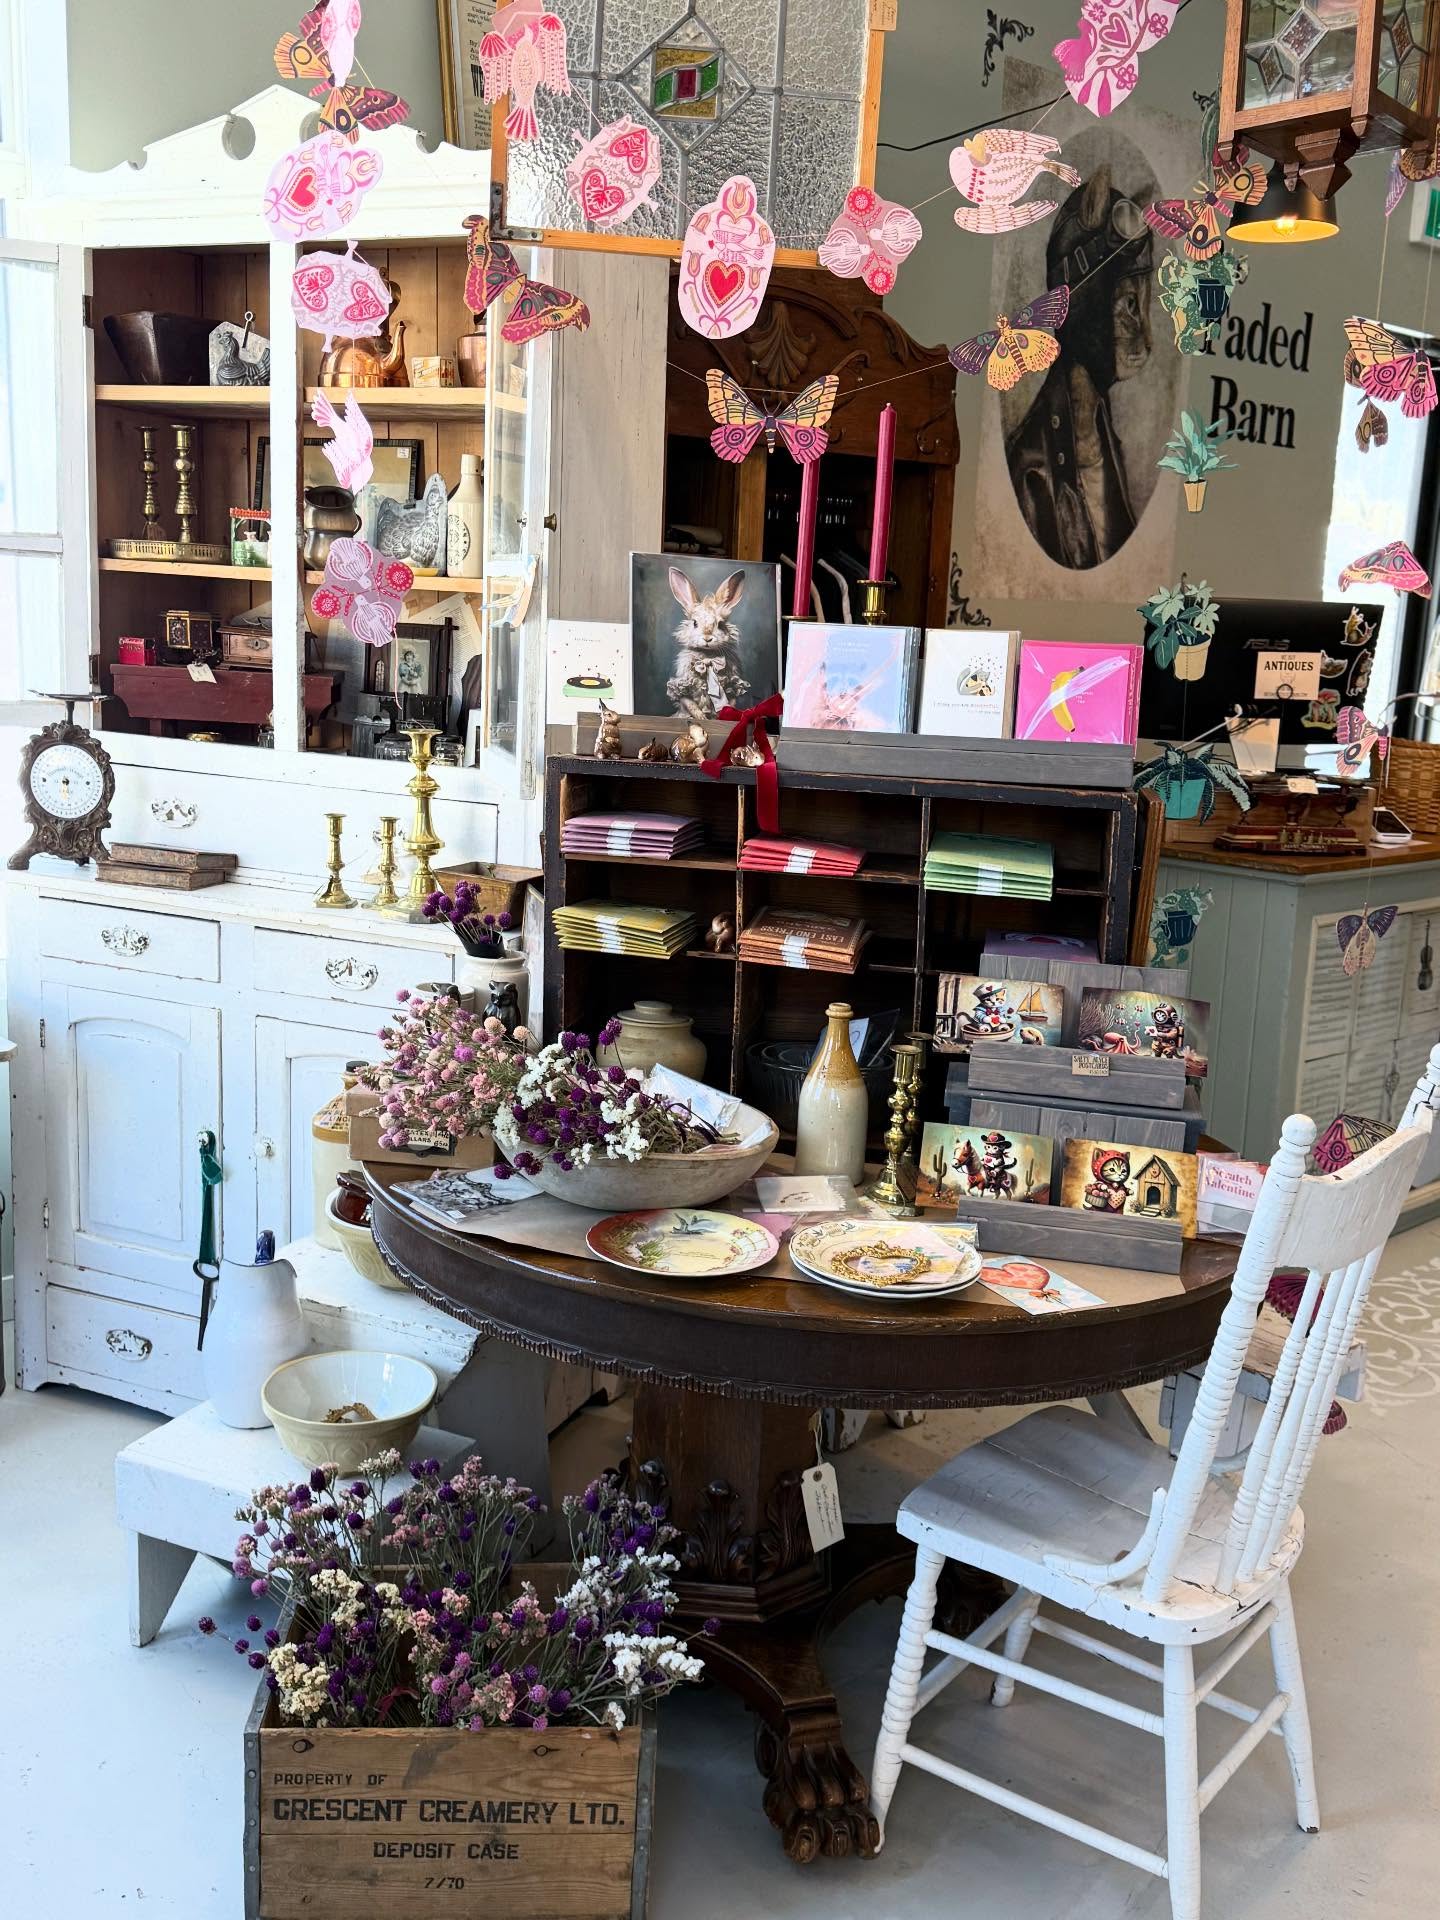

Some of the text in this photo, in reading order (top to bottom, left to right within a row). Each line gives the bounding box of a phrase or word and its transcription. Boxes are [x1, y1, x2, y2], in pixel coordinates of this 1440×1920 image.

[1207, 375, 1296, 449] Barn
[1264, 661, 1314, 671] ANTIQUES
[1212, 1166, 1252, 1186] Scratch
[1205, 1176, 1256, 1199] Valentine
[274, 1773, 388, 1786] PROPERTY OF
[273, 1798, 625, 1825] CRESCENT CREAMERY LTD.
[373, 1841, 520, 1860] DEPOSIT CASE
